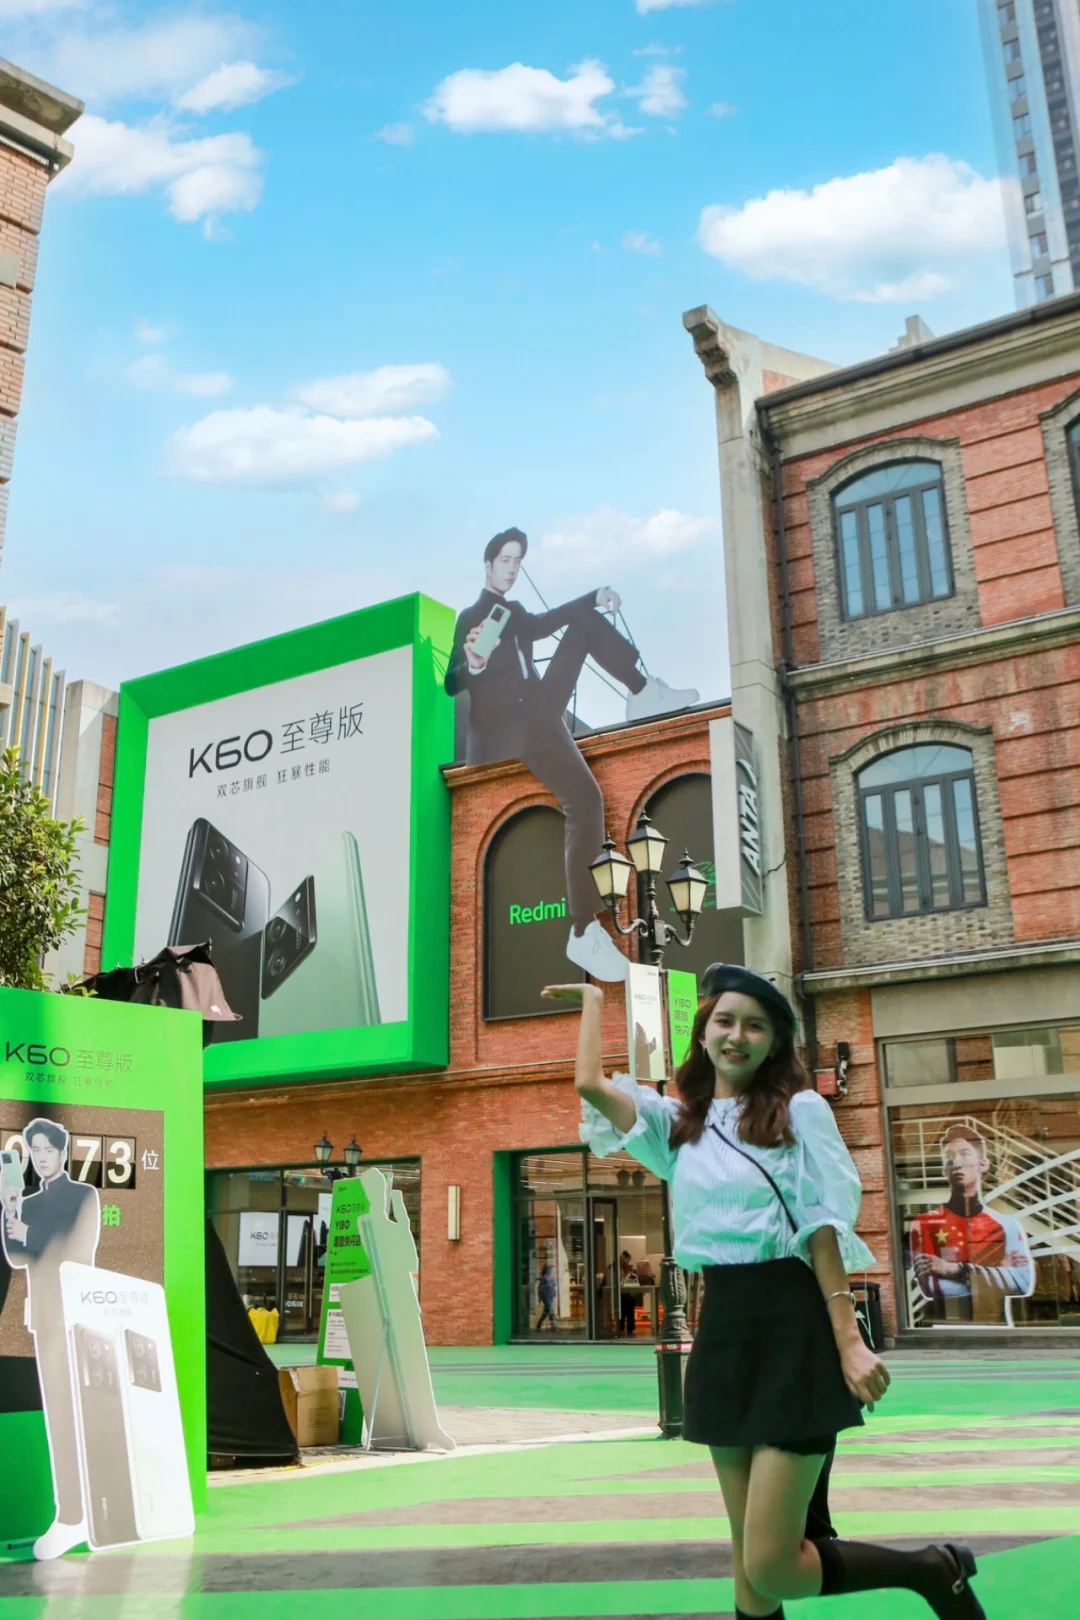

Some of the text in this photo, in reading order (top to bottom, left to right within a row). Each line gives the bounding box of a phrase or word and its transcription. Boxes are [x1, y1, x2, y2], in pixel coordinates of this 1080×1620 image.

[188, 702, 364, 778] K60 至尊版
[216, 758, 330, 799] 双芯旗舰 狂暴性能
[739, 784, 761, 878] ANTA
[509, 896, 567, 925] Redmi
[5, 1041, 133, 1074] K60 至尊版
[141, 1149, 160, 1171] 位
[102, 1204, 121, 1227] 拍
[80, 1291, 117, 1305] K60
